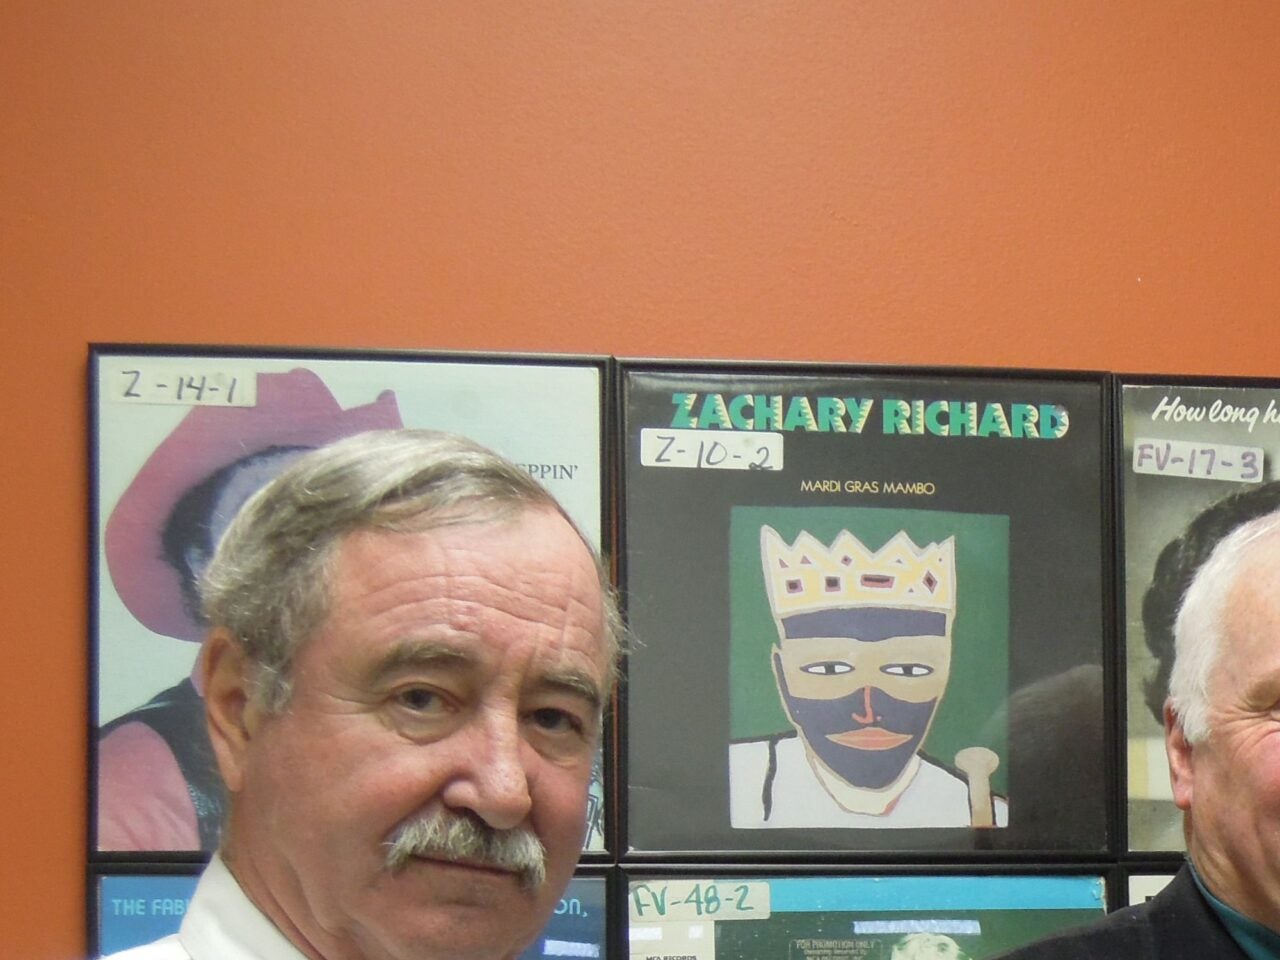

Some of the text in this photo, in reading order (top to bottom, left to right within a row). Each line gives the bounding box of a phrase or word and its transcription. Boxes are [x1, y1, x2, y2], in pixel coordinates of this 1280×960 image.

[670, 392, 1070, 440] ZACHARY RICHARD
[1152, 396, 1206, 423] How
[1208, 399, 1260, 433] long
[655, 435, 774, 471] Z-10-2
[1138, 442, 1260, 480] FV-17-3
[801, 479, 936, 495] MARDI GRAS MAMBO
[111, 898, 189, 916] THE FAB
[631, 884, 755, 916] FV-48-2
